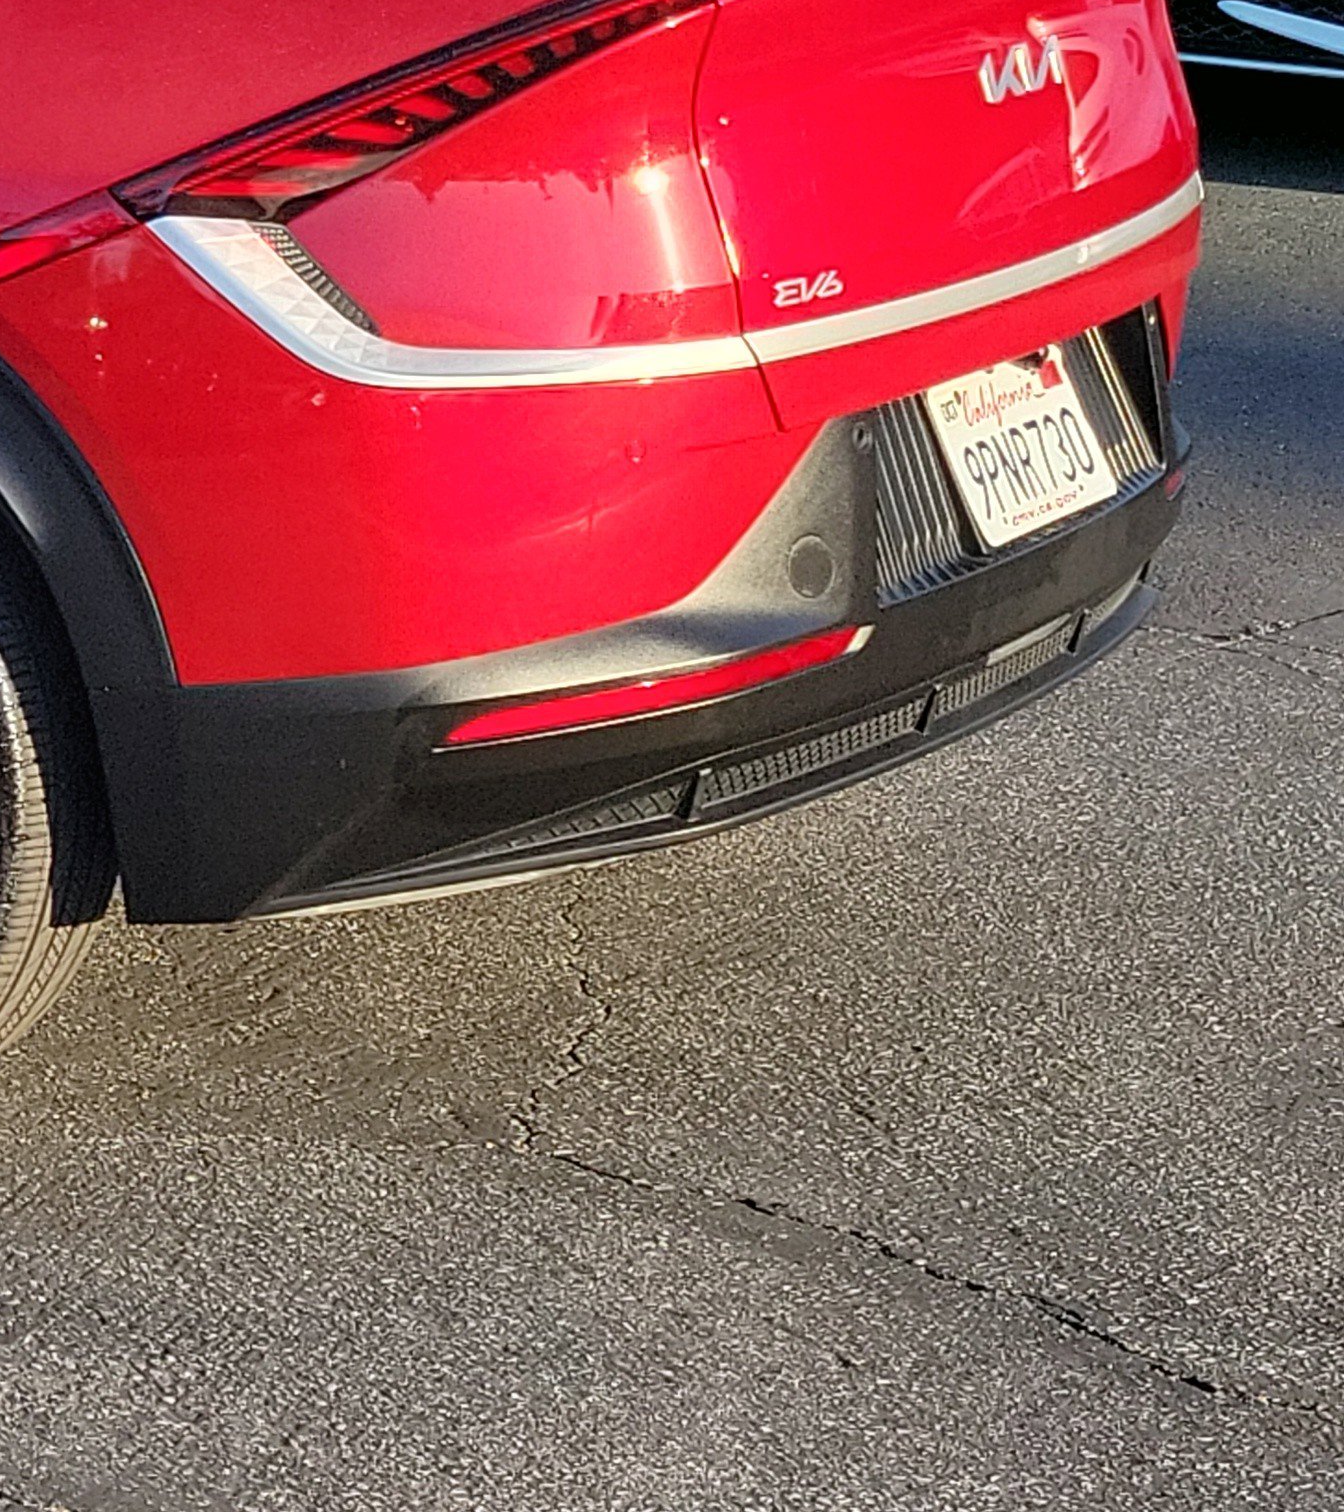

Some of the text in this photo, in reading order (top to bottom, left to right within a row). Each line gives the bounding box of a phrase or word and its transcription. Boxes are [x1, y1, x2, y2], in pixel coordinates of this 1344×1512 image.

[978, 34, 1063, 104] KIA
[773, 269, 844, 309] EV6
[962, 381, 1033, 428] California
[963, 407, 1095, 521] 9PNR730
